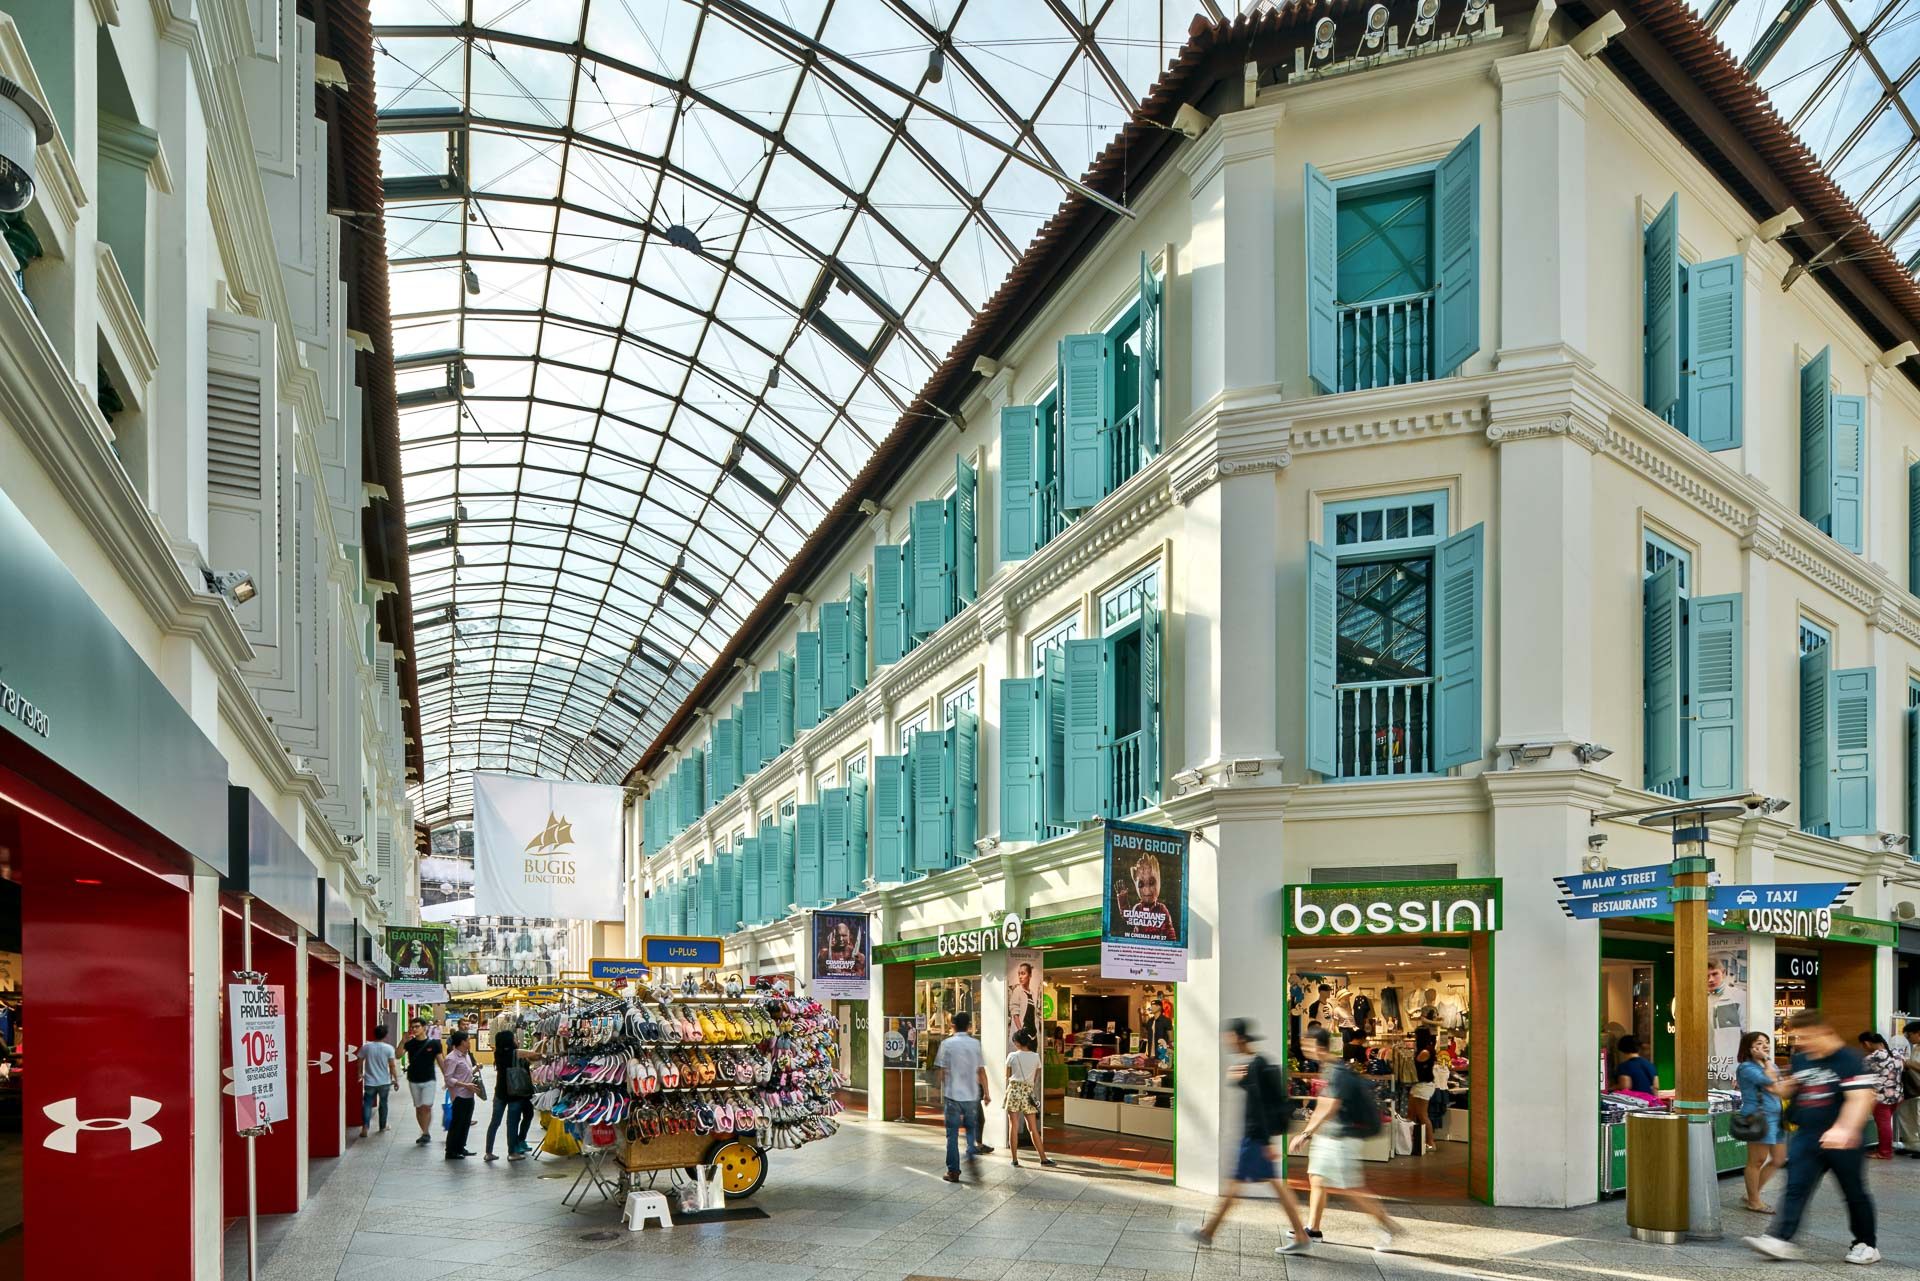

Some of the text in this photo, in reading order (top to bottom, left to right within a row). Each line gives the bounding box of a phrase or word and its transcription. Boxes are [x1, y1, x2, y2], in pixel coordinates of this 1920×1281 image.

[0, 680, 50, 738] 78/79/80
[1113, 834, 1182, 856] BABY GROOT
[524, 859, 576, 875] BUGIS
[524, 874, 576, 884] JUNCTION
[1581, 871, 1657, 890] MALAY STREET
[1766, 890, 1798, 903] TAXI
[1294, 886, 1495, 935] bossini
[1592, 897, 1658, 913] RESTAURANTS
[1123, 909, 1166, 921] GUARDIANS
[1133, 918, 1165, 928] GALAXY
[391, 931, 438, 942] GAMORA
[938, 925, 998, 956] bossini
[669, 947, 697, 957] U-PLUS
[242, 991, 275, 1004] TOURIST
[240, 1005, 278, 1018] PRIVILEGE
[266, 1051, 278, 1062] OFF
